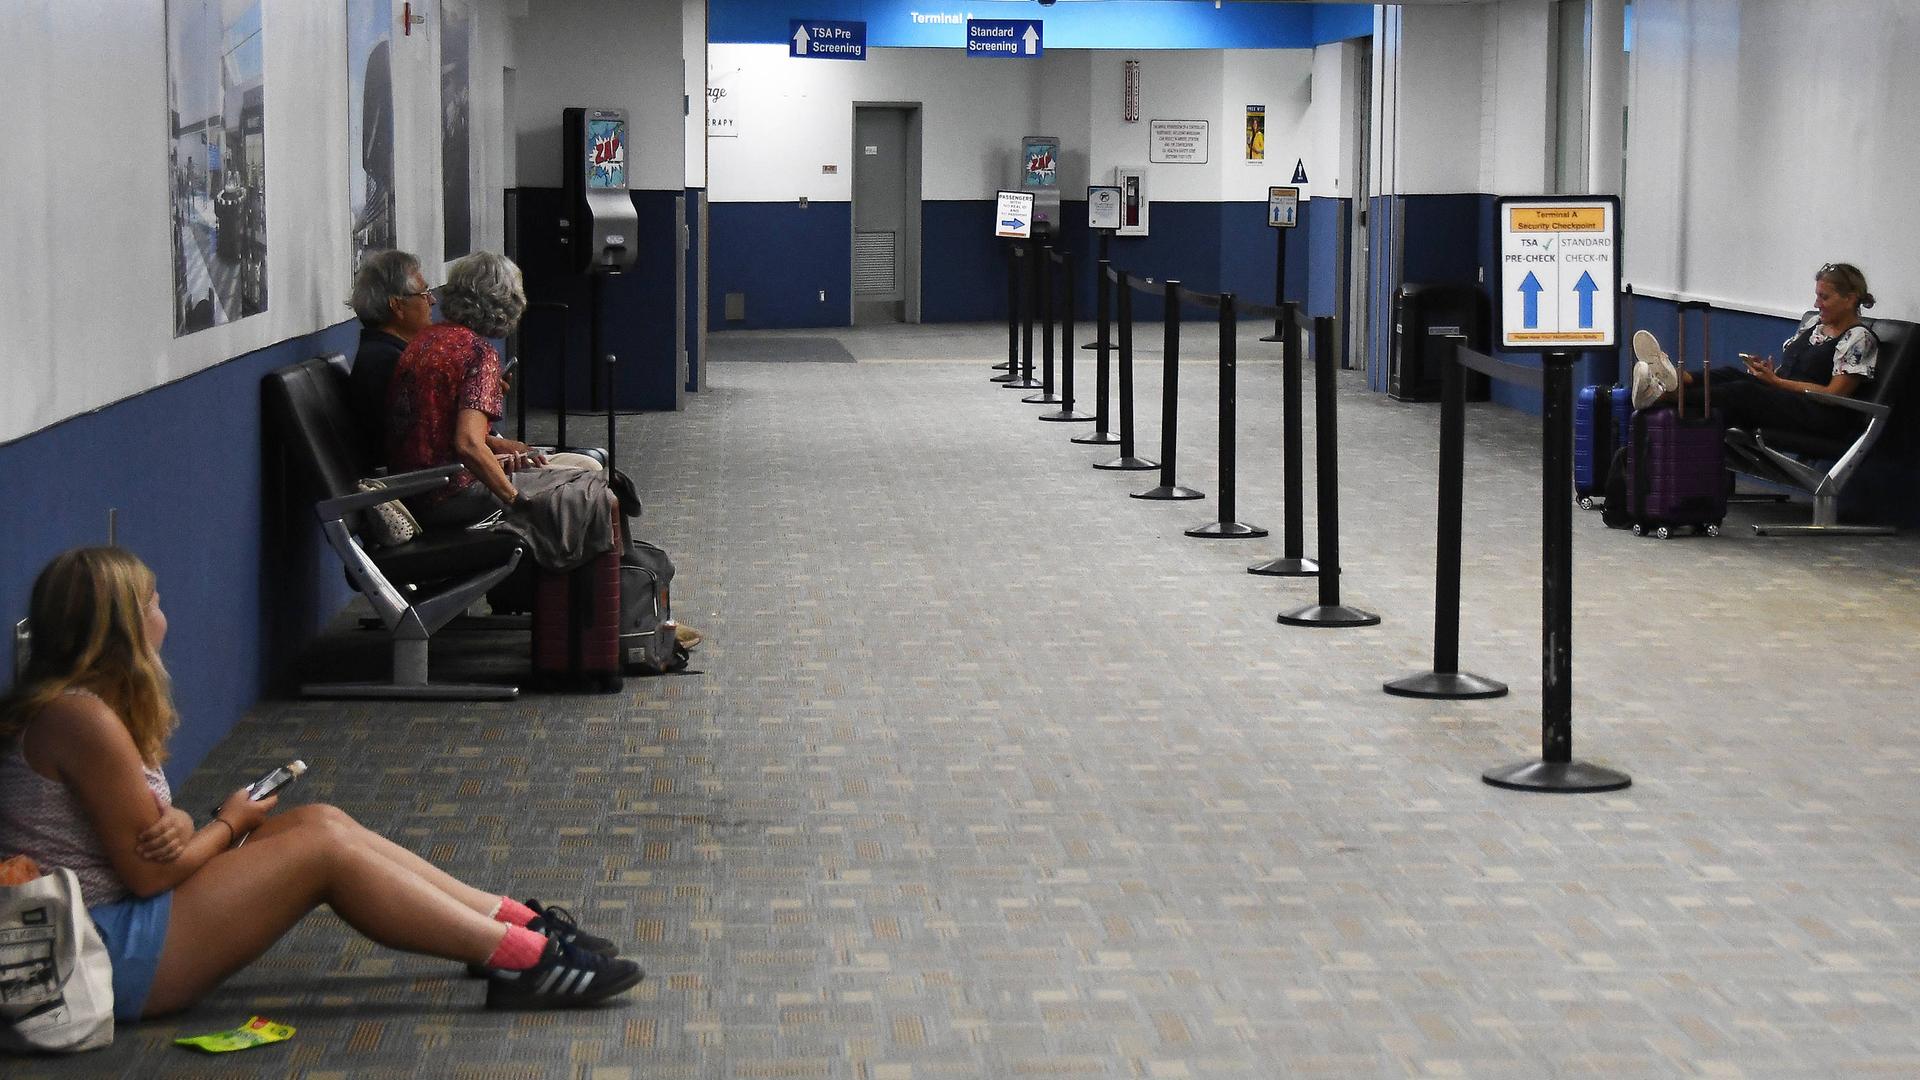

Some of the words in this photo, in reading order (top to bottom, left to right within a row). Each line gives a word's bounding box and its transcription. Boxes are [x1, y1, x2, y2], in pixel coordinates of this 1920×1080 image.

[911, 12, 963, 24] Terminal
[812, 27, 833, 39] TSA
[835, 28, 851, 39] Pre
[970, 26, 1014, 37] Standard
[813, 41, 862, 56] Screening
[969, 40, 1018, 54] Screening
[1518, 222, 1550, 230] Security
[1552, 222, 1596, 230] Checkpoint
[1521, 238, 1538, 247] TSA
[1561, 238, 1611, 247] STANDARD
[1505, 254, 1555, 263] PRE-CHECK
[1565, 254, 1608, 263] CHECK-IN
